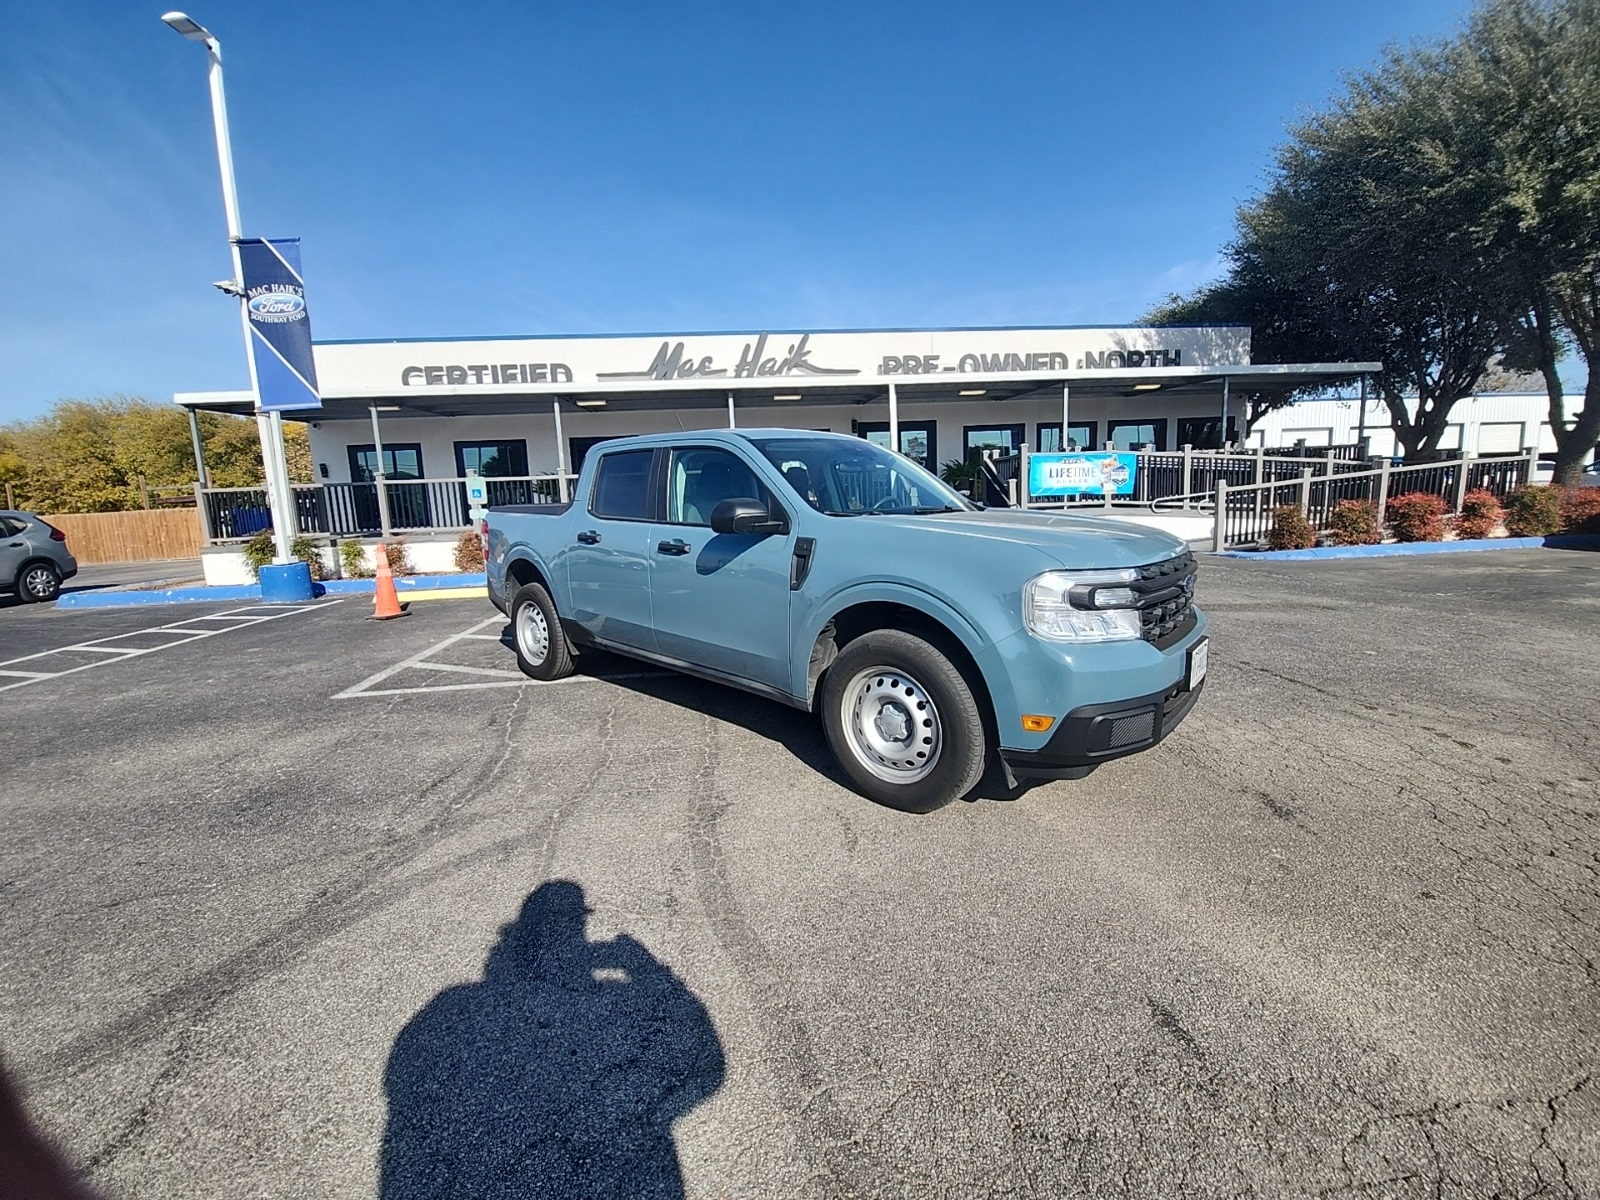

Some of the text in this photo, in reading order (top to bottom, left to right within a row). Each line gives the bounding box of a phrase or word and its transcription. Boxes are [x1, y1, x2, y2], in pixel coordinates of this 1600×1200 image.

[247, 283, 303, 298] MAC HAIK'S
[259, 297, 296, 313] Ford
[250, 310, 306, 324] SOUTHWAY FORD
[642, 330, 828, 380] Mac Haik
[882, 349, 1181, 375] PRE-OWNED NORTH
[401, 363, 574, 386] CERTIFIED
[1048, 467, 1097, 478] LIFETIME
